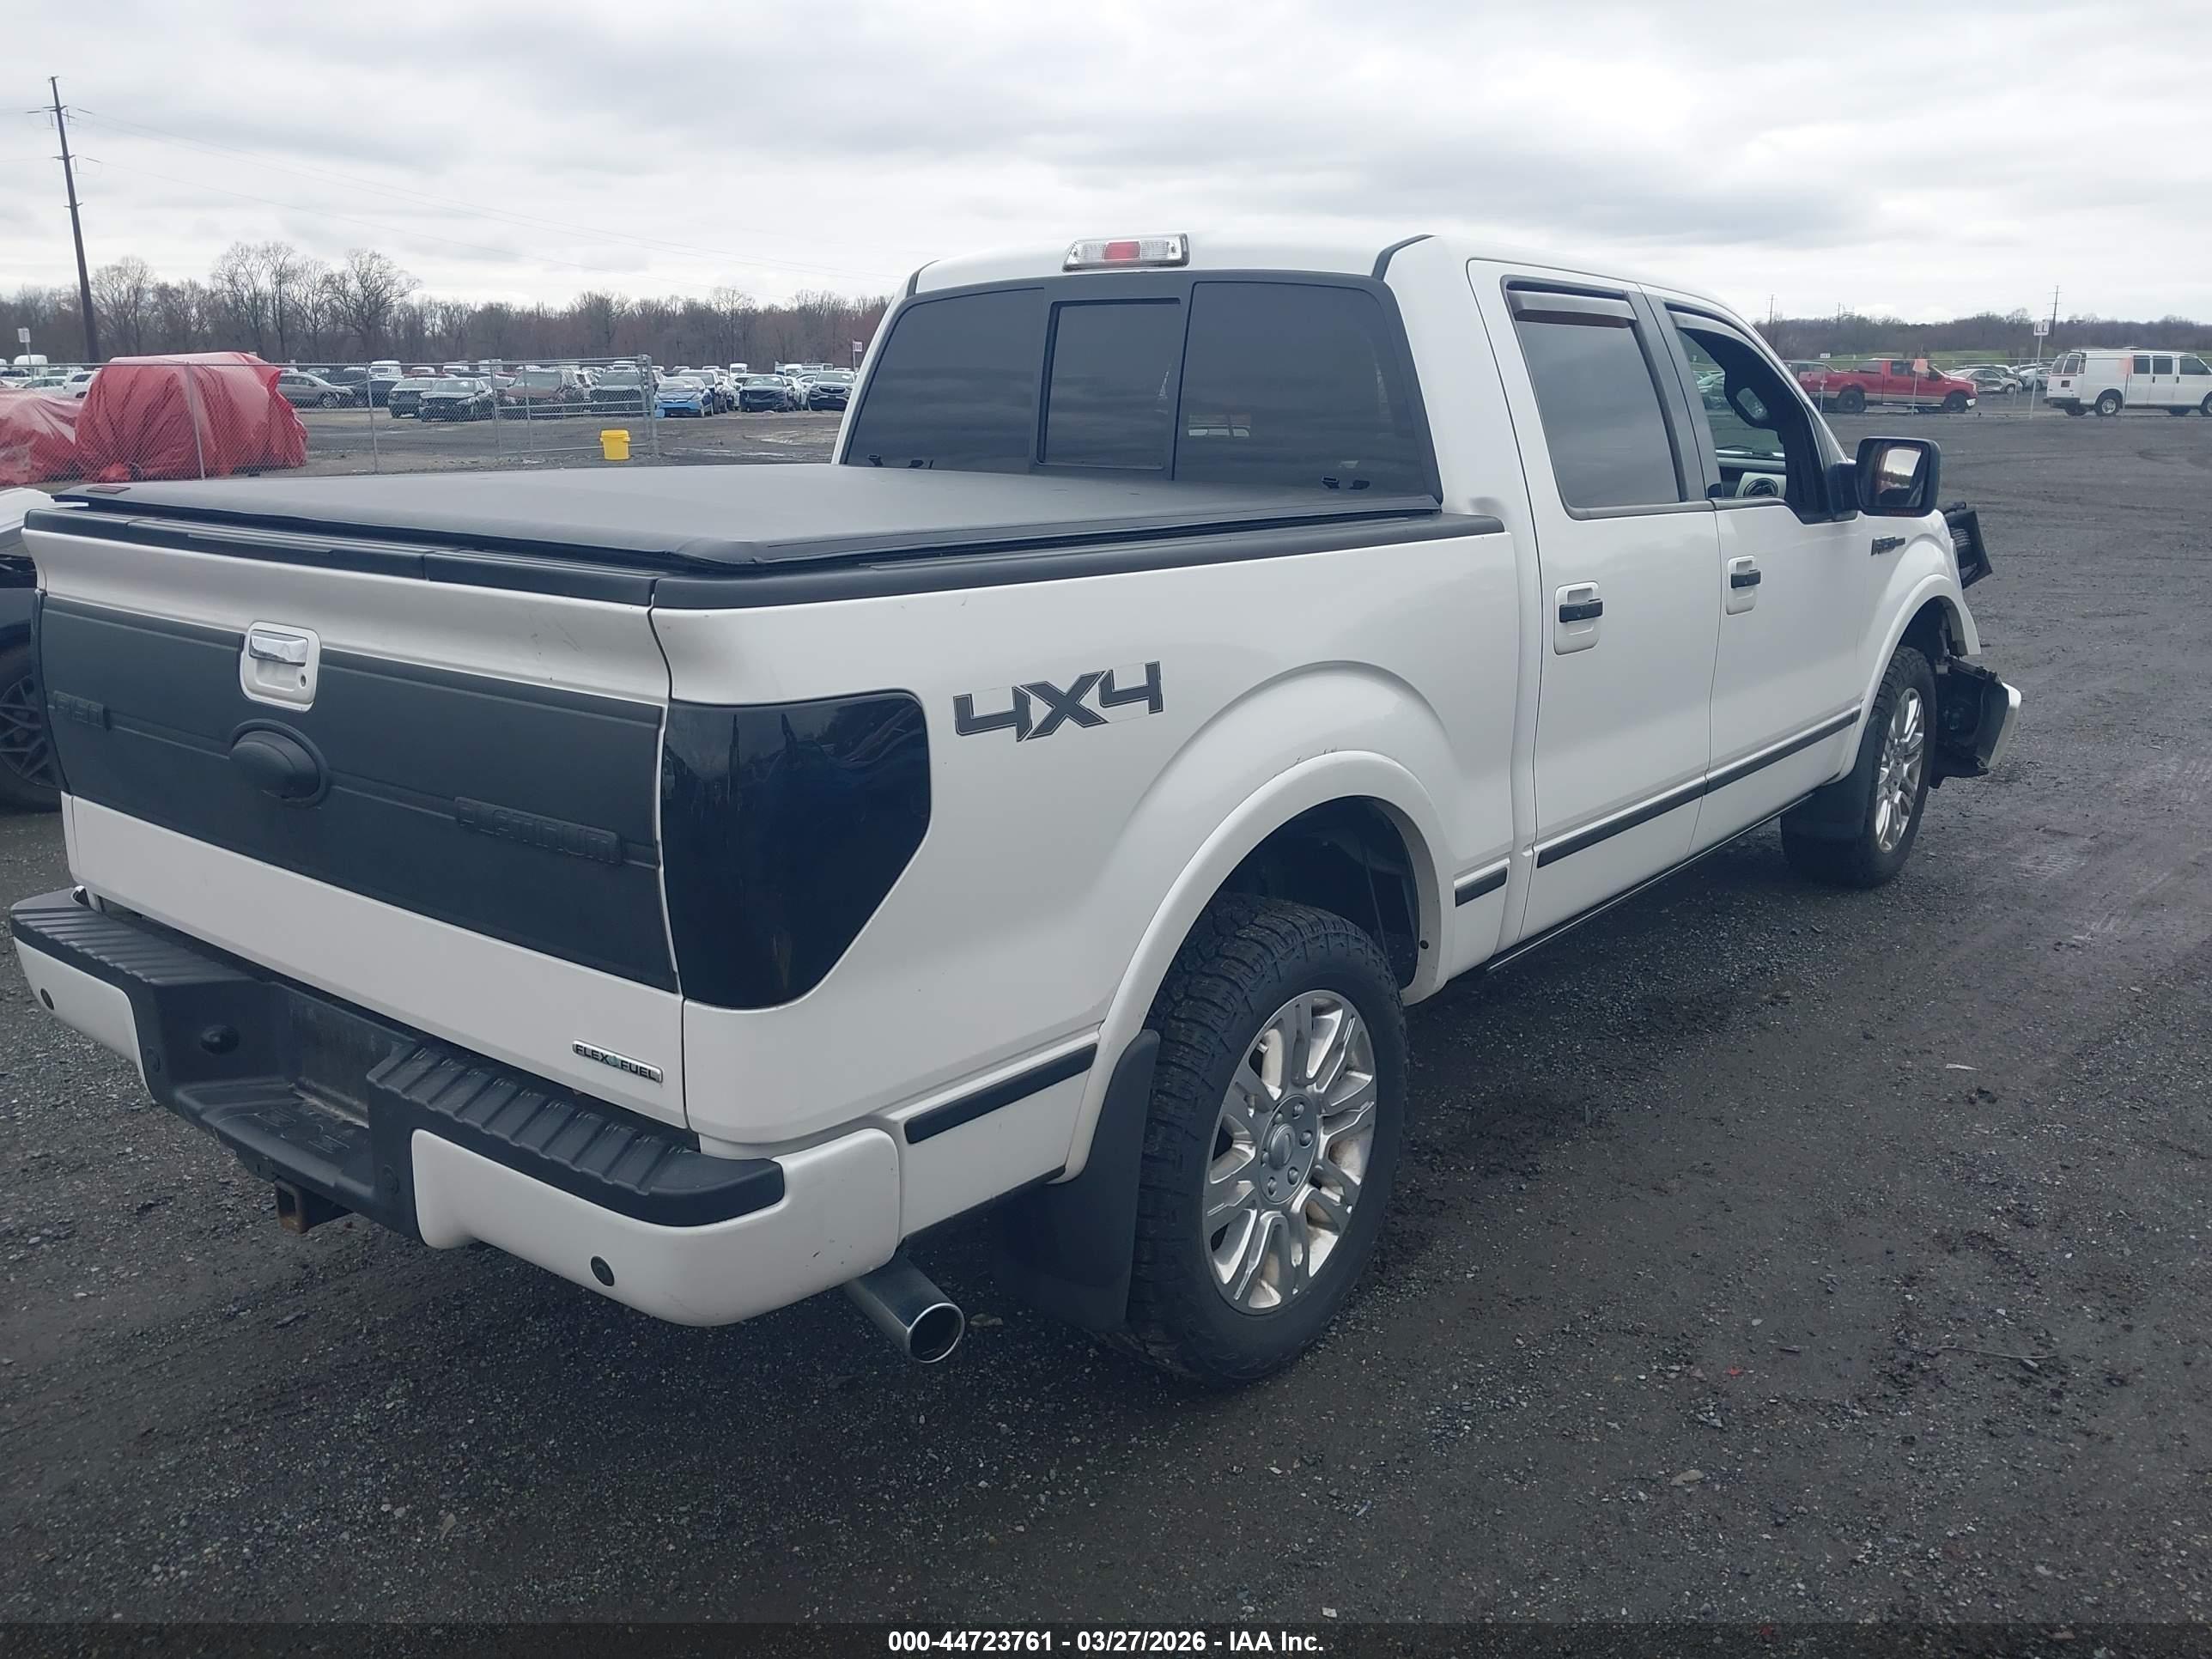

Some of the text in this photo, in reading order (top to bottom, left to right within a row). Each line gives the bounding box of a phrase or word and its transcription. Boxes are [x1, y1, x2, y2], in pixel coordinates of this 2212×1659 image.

[953, 660, 1164, 743] 4X4
[575, 1043, 657, 1081] FLEX FUEL
